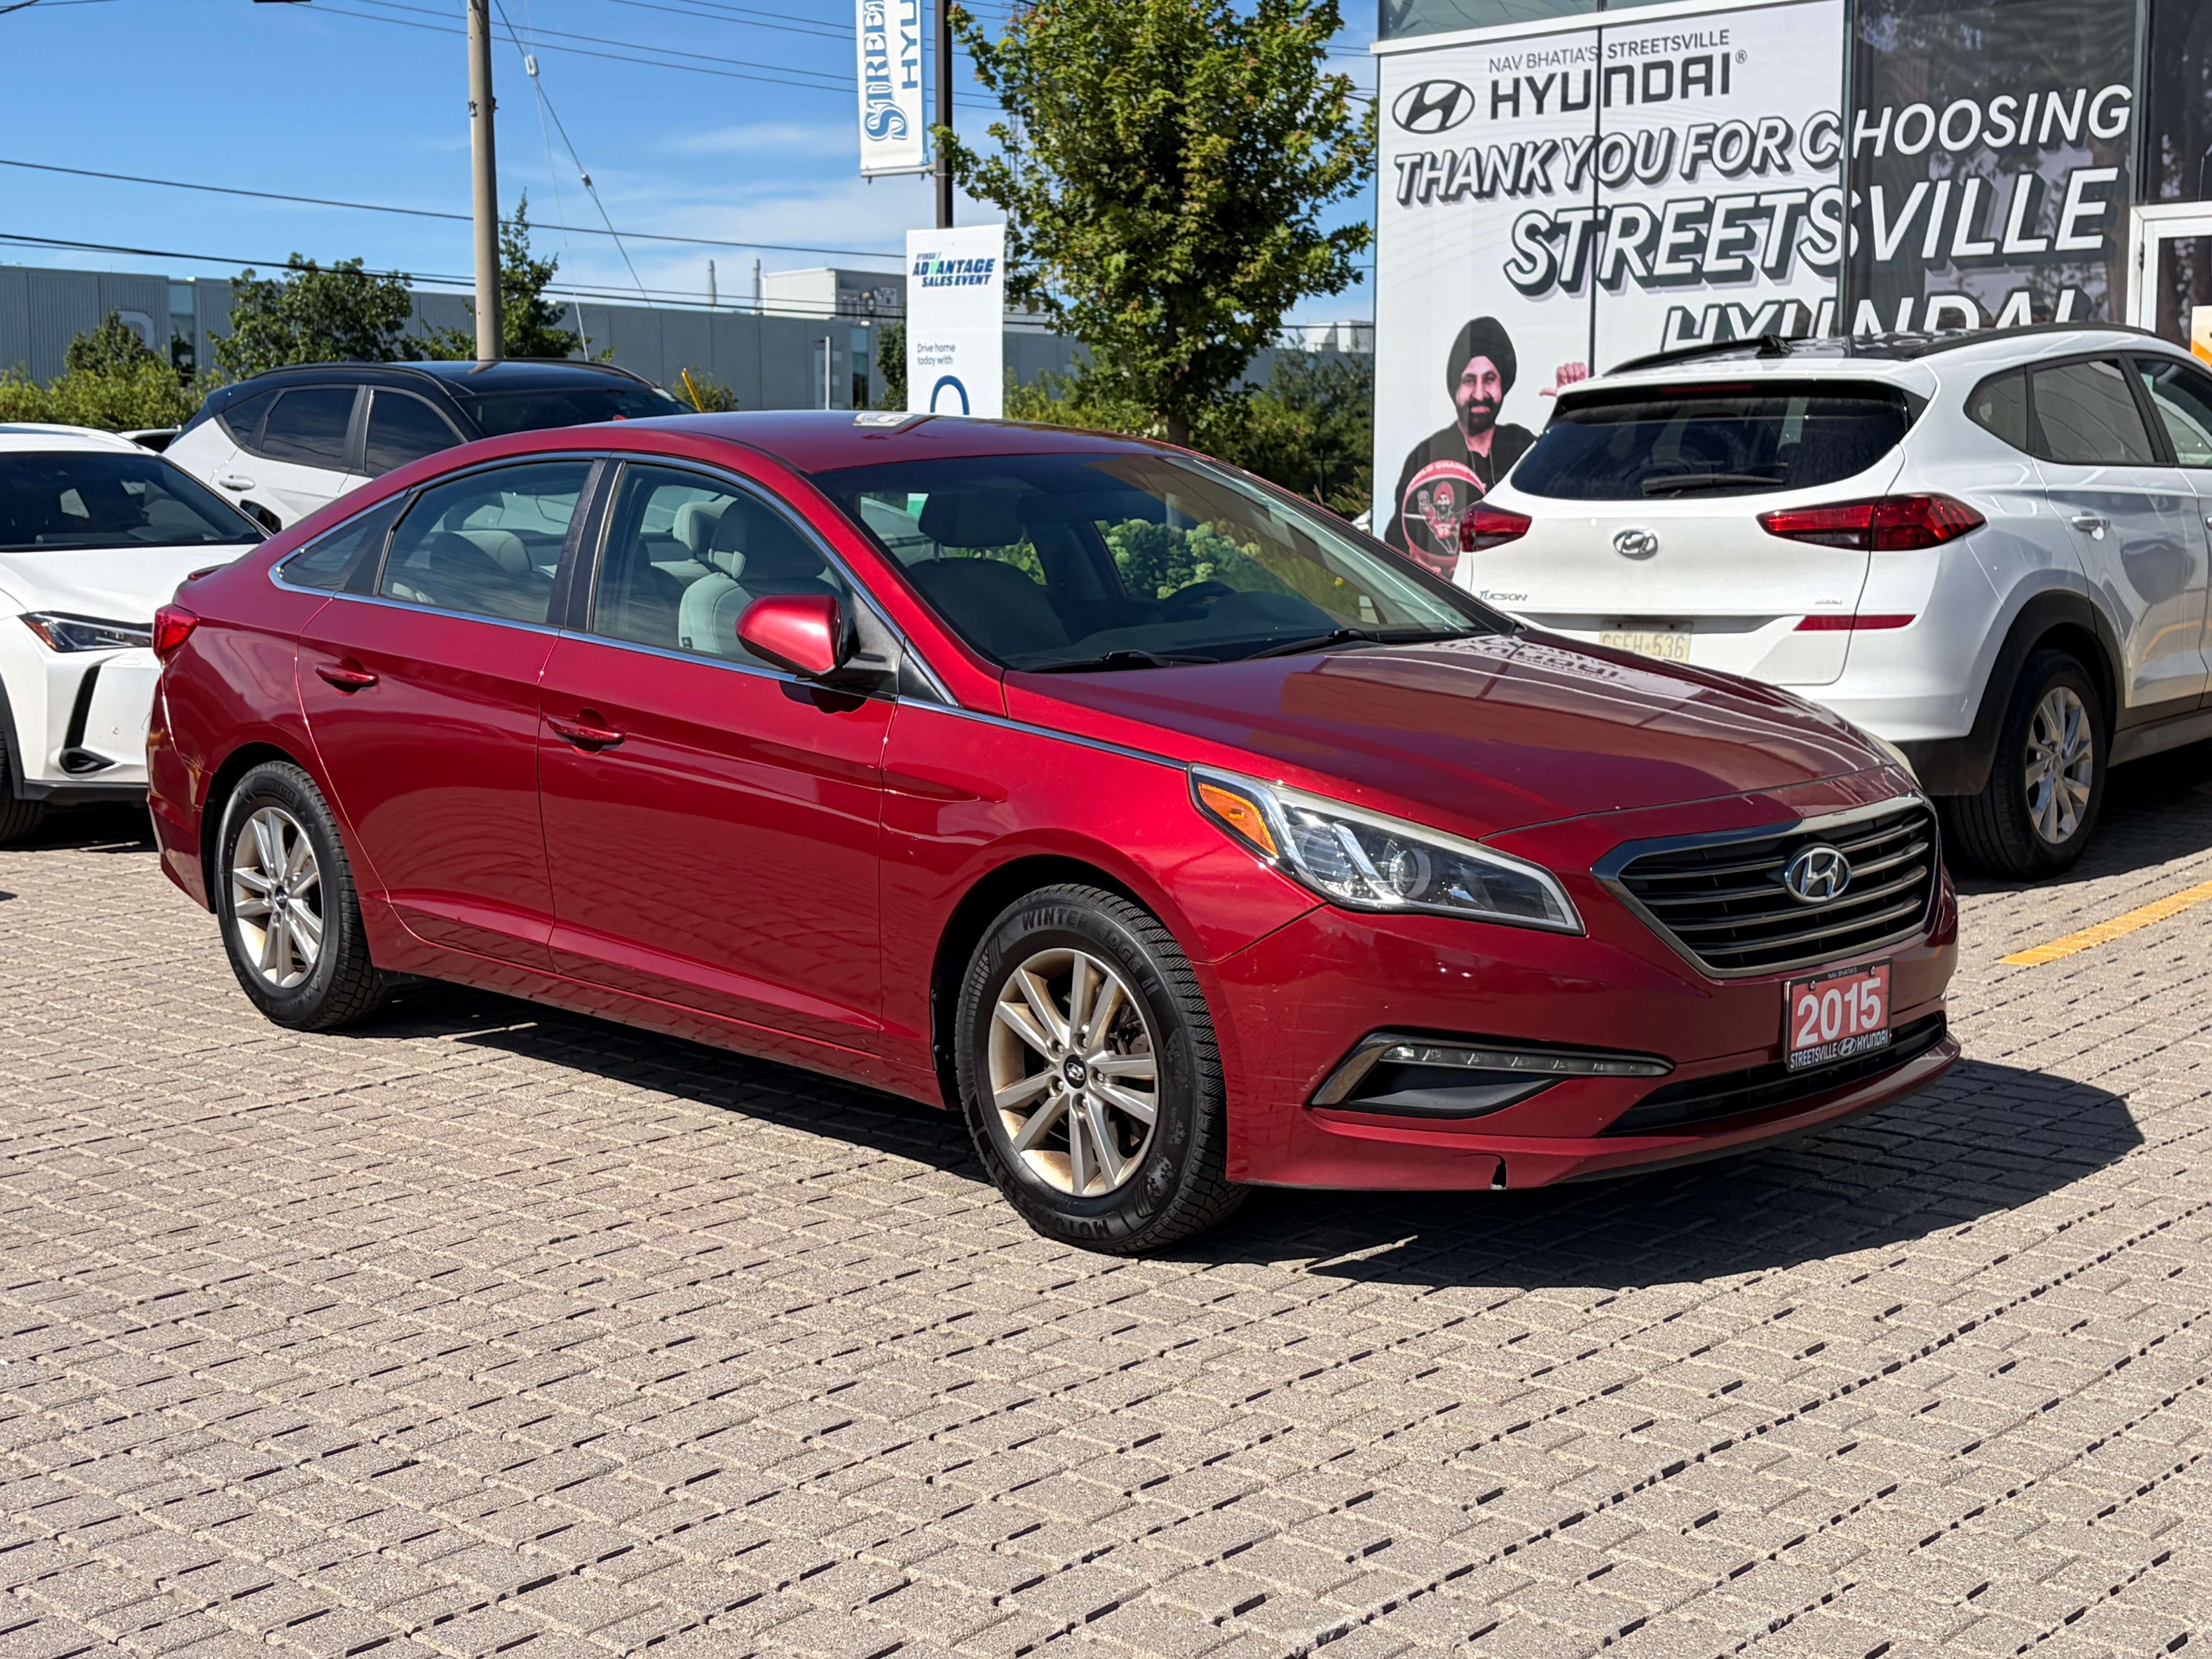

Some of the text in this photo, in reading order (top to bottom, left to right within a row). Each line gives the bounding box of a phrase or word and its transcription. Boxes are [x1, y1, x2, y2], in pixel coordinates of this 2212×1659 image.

[1489, 29, 1730, 73] NAV BHATIA'S STREETSVILLE
[1490, 52, 1730, 120] HYUNDAI
[1395, 84, 2133, 206] THANK YOU FOR CHOOSING
[1503, 167, 2121, 297] STREETSVILLE
[912, 257, 996, 276] ADVANTAGE
[921, 274, 992, 287] SALES EVENT
[917, 343, 956, 353] Drive home
[917, 354, 953, 367] today with
[1479, 590, 1528, 601] TUCSON
[1652, 634, 1685, 658] 536
[1022, 908, 1087, 931] WINTER
[1096, 928, 1143, 973] EDGE
[1796, 977, 1881, 1047] 2015
[1790, 1029, 1888, 1069] STREETSVILLE HYUNDAI
